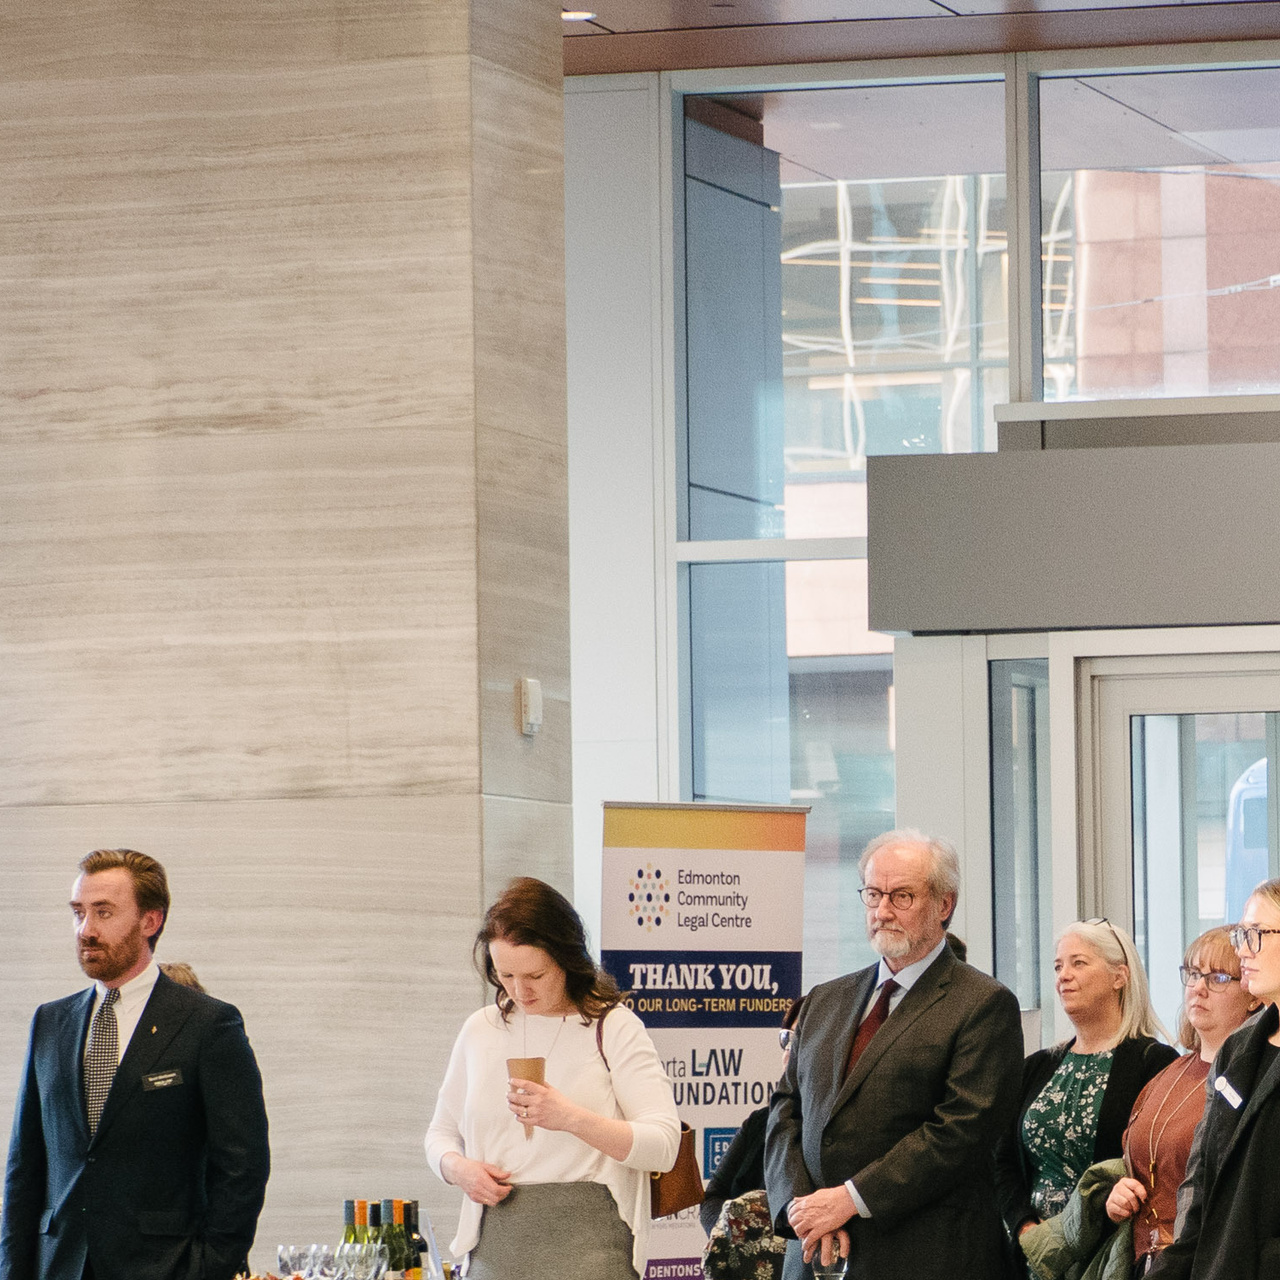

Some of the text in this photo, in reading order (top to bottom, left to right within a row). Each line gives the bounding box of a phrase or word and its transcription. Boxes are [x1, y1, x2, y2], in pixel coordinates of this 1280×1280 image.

[677, 869, 741, 885] Edmonton
[677, 891, 748, 911] Community
[677, 912, 752, 931] Legal Centre
[629, 963, 779, 995] THANK YOU,
[638, 998, 663, 1012] OUR
[665, 998, 736, 1012] LONG-TERM
[691, 1048, 743, 1076] LAW
[649, 1264, 701, 1279] DENTONS
